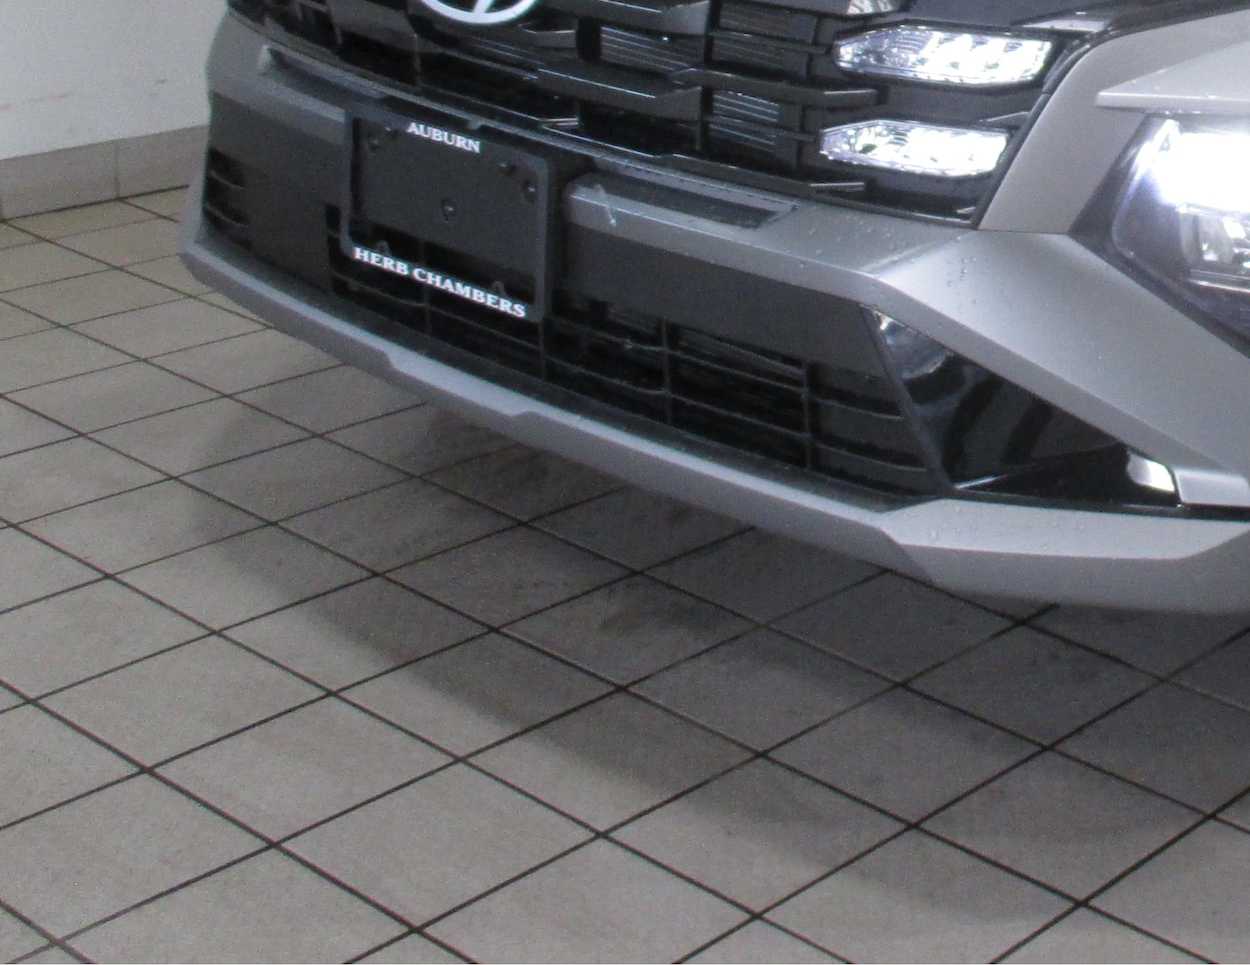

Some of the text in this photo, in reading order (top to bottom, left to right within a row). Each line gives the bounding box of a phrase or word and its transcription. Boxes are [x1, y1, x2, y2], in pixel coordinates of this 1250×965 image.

[406, 121, 481, 153] AUBURN
[353, 246, 527, 318] HERB CHAMBERS
